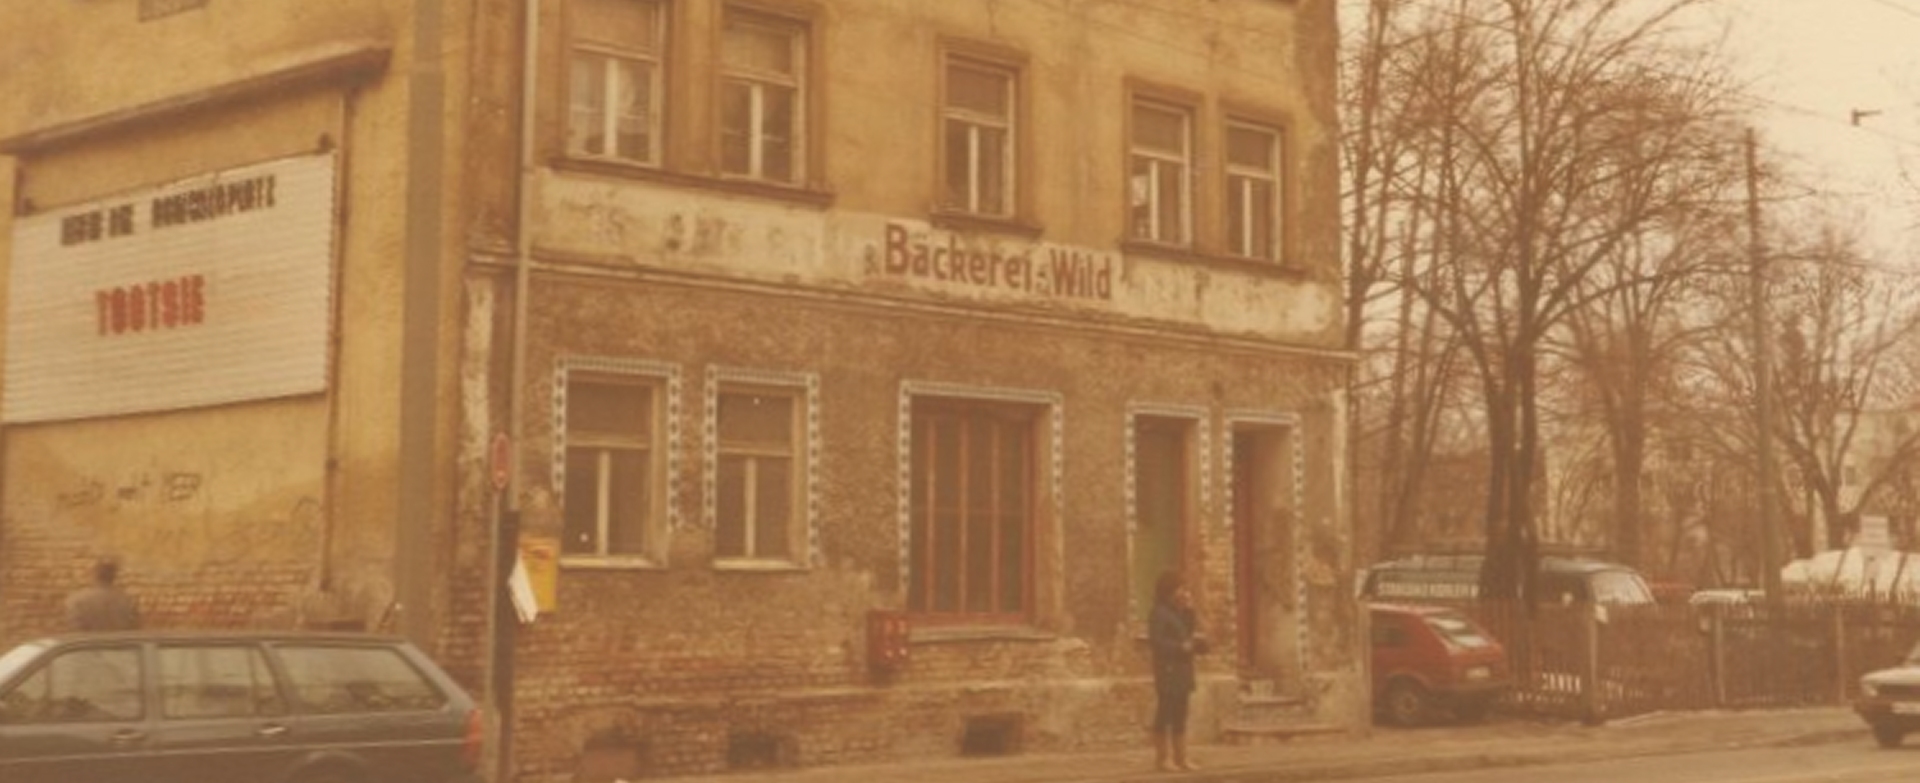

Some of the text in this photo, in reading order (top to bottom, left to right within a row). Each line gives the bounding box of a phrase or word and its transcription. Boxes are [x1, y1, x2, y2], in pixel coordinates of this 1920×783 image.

[885, 222, 1033, 293] Bäckerei
[1049, 248, 1112, 300] Wild
[95, 273, 205, 336] TOOTSIE
